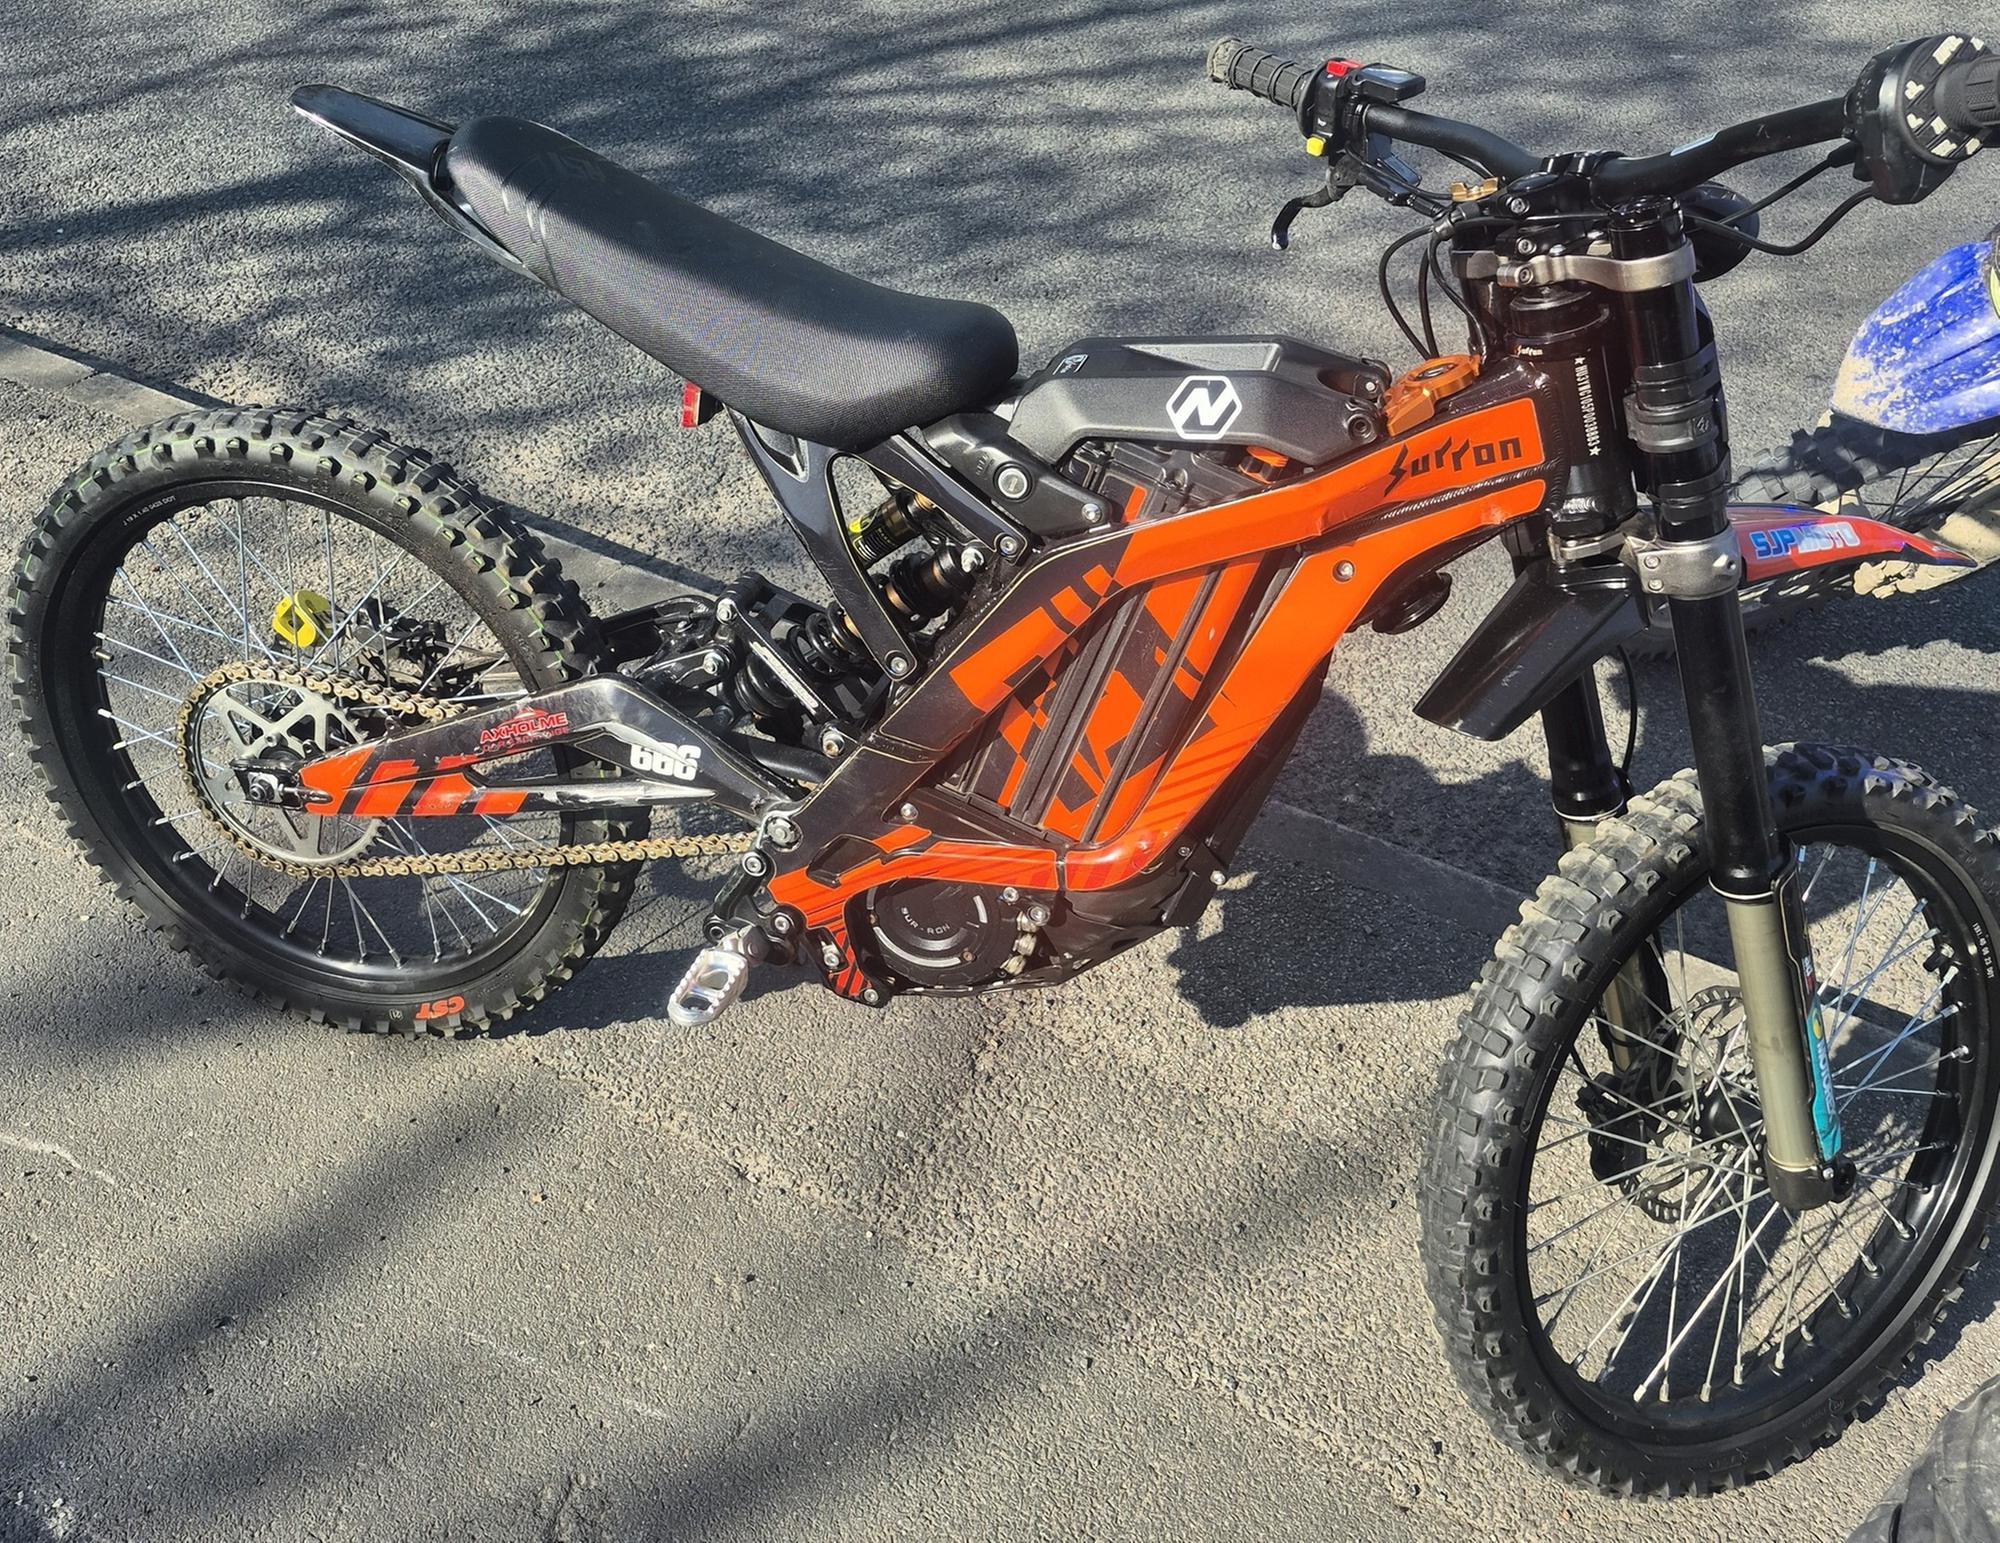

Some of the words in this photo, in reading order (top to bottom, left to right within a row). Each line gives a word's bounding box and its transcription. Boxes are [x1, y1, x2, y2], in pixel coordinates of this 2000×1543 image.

[480, 712, 568, 744] AXHOLME
[630, 741, 702, 781] 666
[415, 995, 465, 1020] CST
